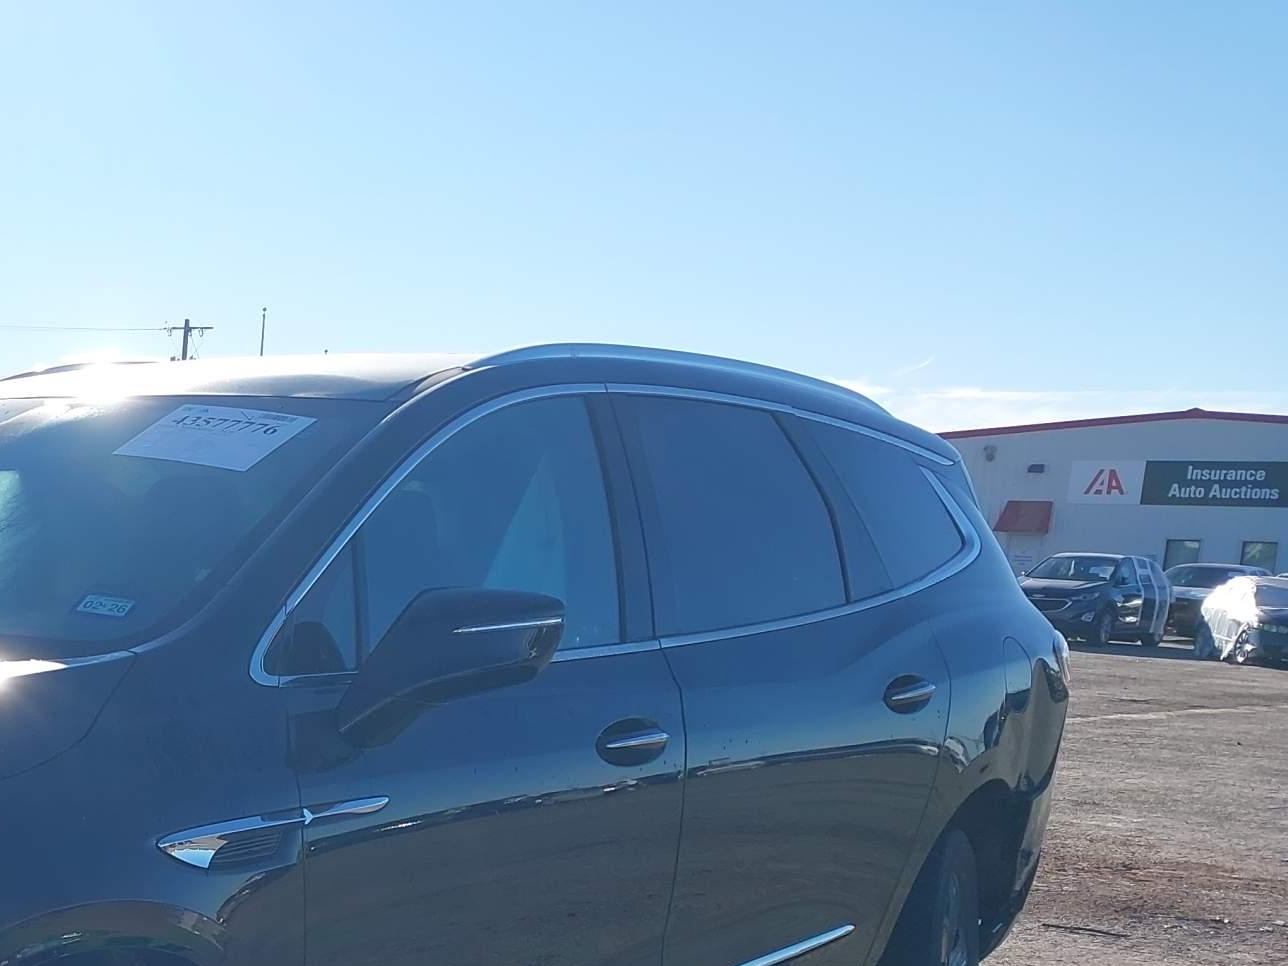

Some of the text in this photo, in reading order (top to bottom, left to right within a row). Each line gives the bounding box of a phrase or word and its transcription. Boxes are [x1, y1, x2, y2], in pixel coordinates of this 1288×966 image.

[172, 415, 281, 435] 43577776
[1187, 465, 1266, 482] Insurance
[1168, 483, 1280, 500] Auto Auctions
